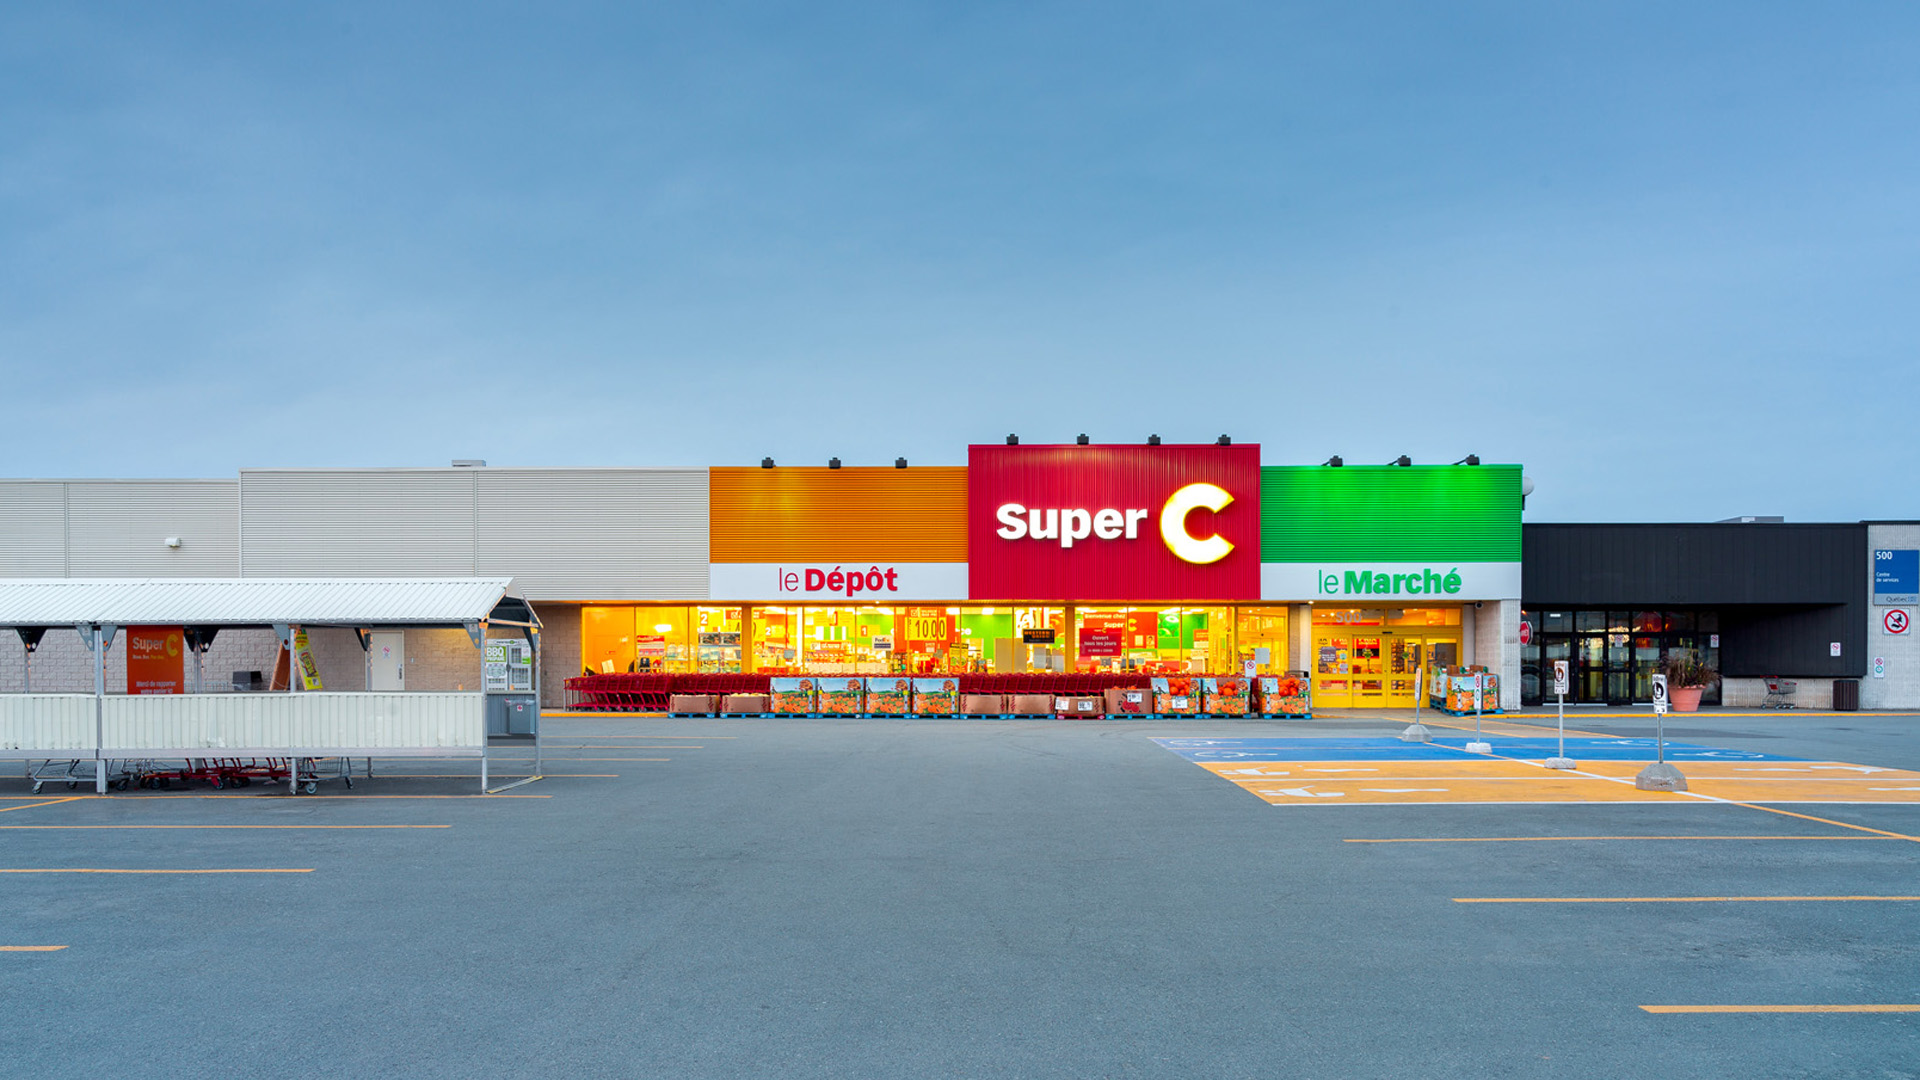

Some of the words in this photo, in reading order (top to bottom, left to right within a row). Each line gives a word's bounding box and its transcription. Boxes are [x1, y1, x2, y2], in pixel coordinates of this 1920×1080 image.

[997, 503, 1148, 548] Super
[1160, 482, 1235, 565] C
[1876, 551, 1893, 560] 500
[778, 568, 799, 592] le
[805, 566, 898, 597] Dépôt
[1318, 569, 1339, 595] le
[1344, 567, 1463, 595] Marché
[700, 613, 708, 625] 2
[1336, 611, 1362, 623] 500
[765, 627, 772, 636] 2
[1104, 621, 1125, 629] Super
[1125, 618, 1138, 632] C
[133, 637, 164, 653] Super
[166, 634, 178, 657] C
[486, 647, 504, 657] BBQ
